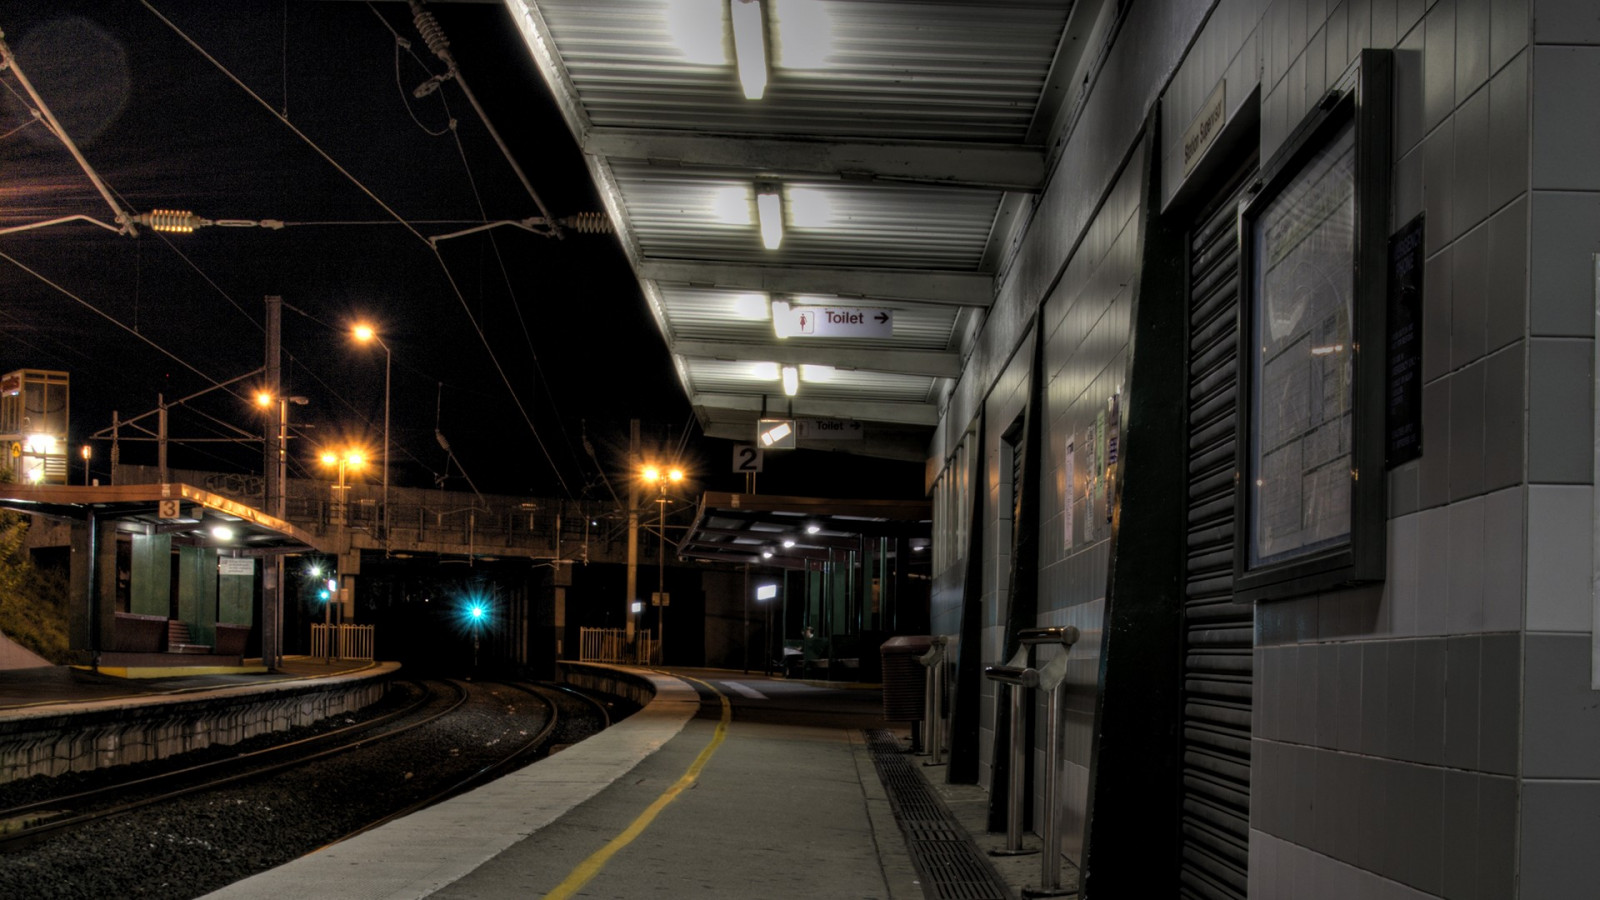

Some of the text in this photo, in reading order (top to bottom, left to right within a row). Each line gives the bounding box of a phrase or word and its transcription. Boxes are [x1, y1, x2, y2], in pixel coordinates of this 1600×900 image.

[825, 310, 864, 324] Toilet
[816, 421, 844, 431] Toilet
[740, 448, 757, 470] 2
[163, 500, 176, 517] 3
